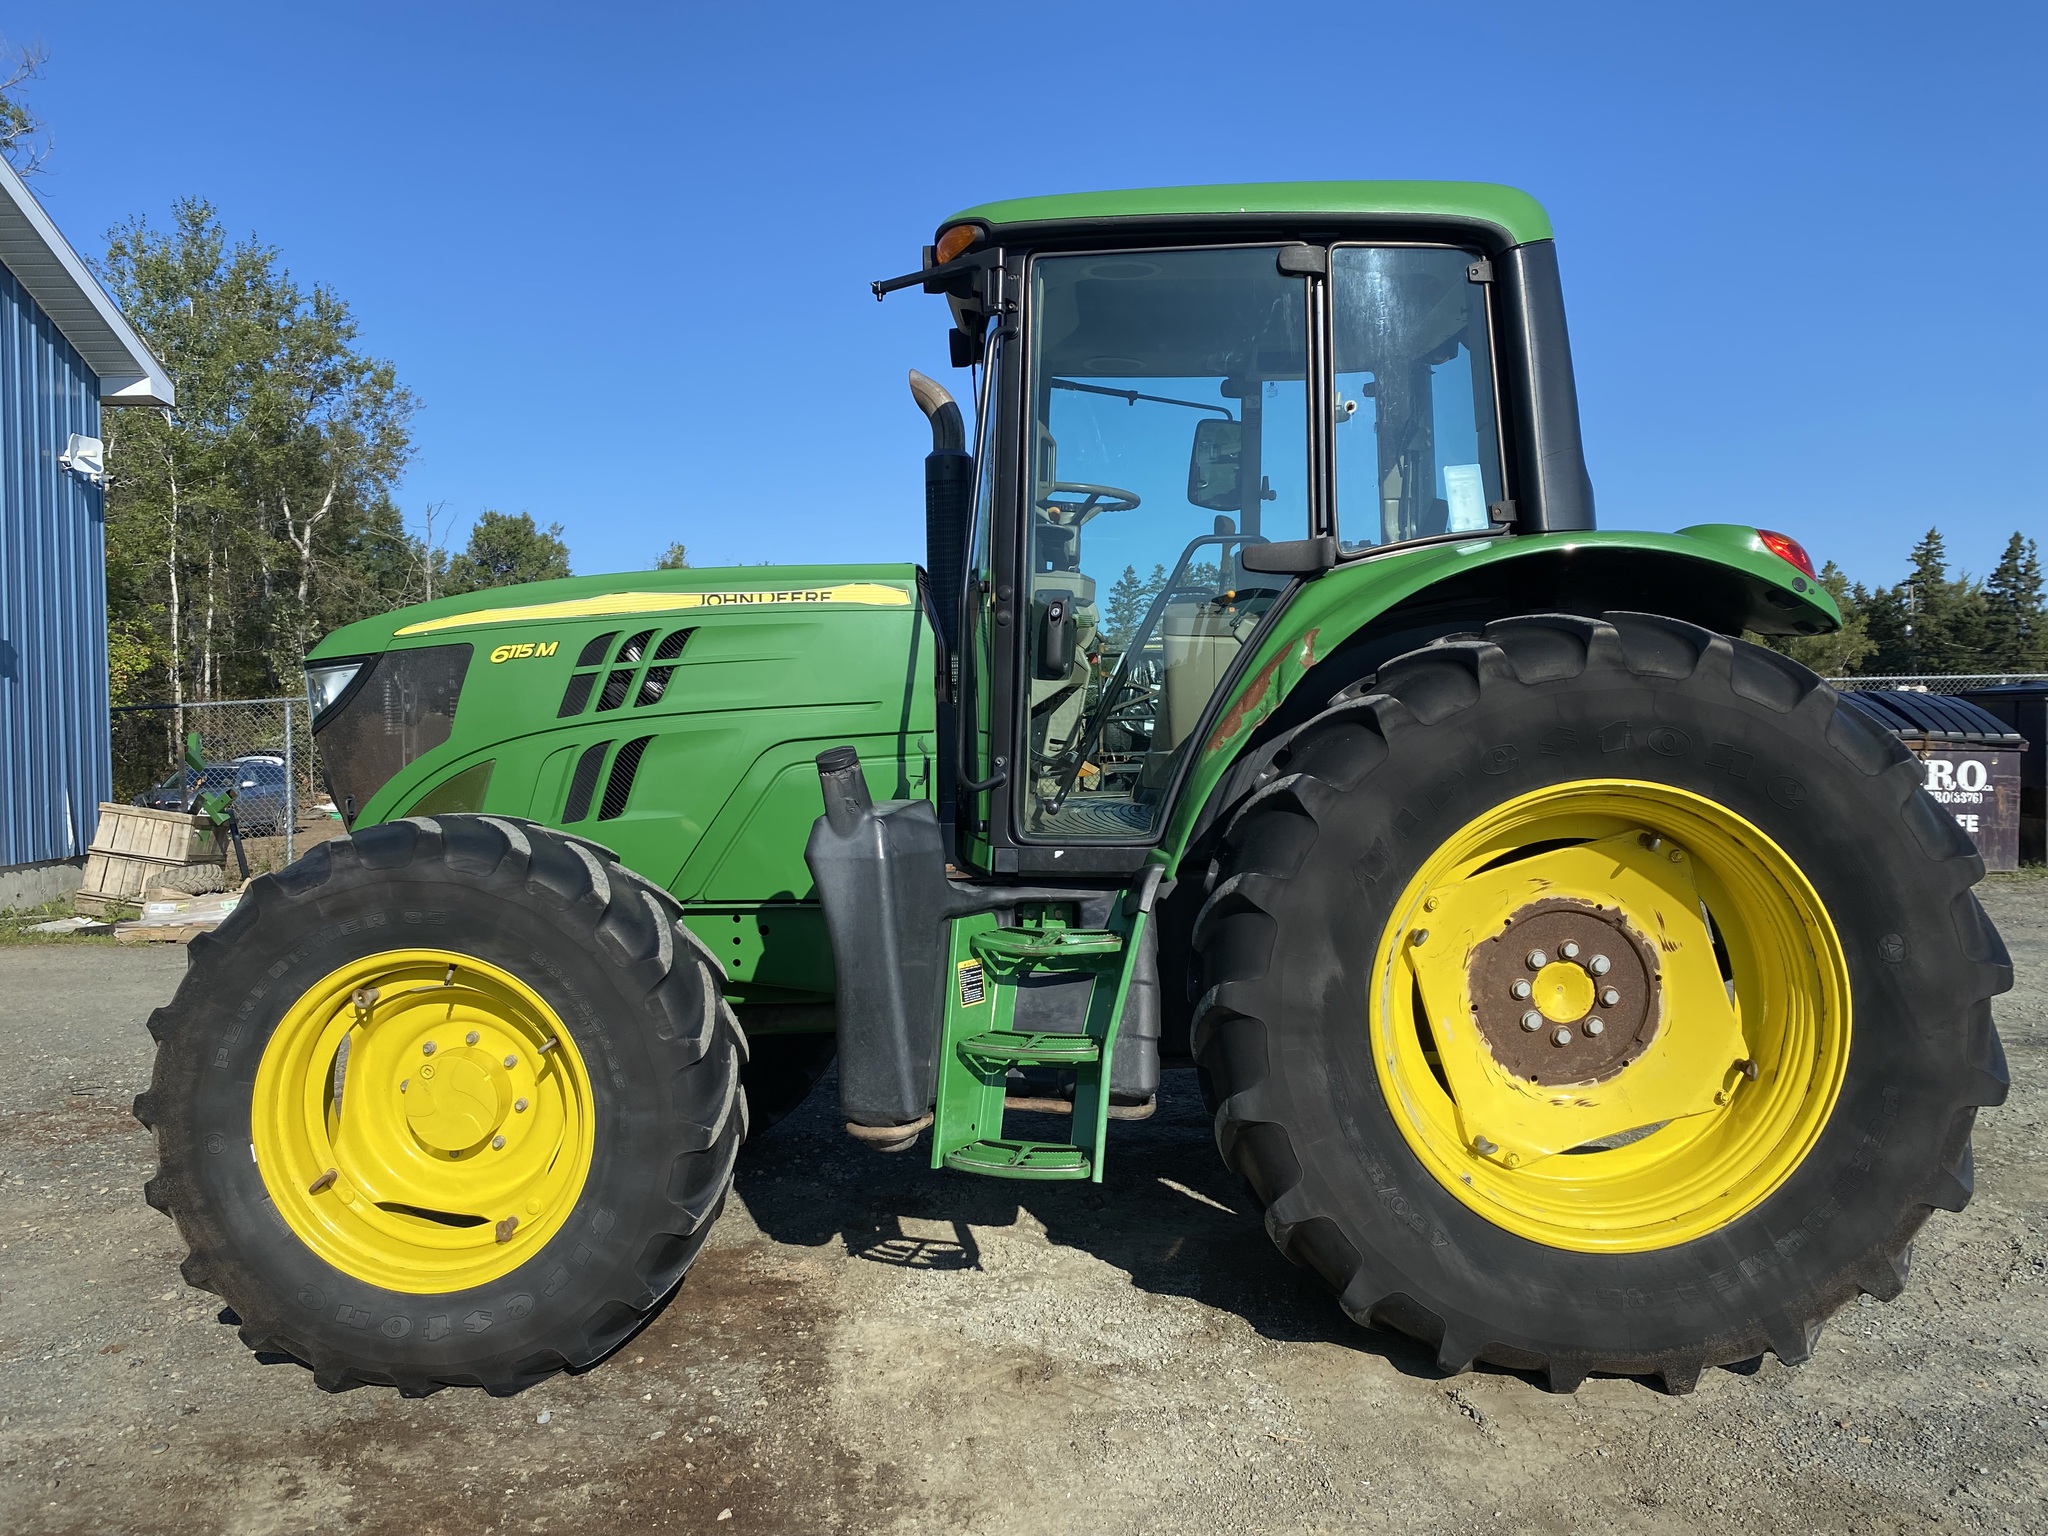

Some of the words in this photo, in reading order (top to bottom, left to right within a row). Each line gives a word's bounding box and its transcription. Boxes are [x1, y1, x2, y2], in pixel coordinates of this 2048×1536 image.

[701, 594, 753, 606] JOHN
[758, 591, 832, 603] DEERE
[214, 911, 387, 1070] PERFORMER
[403, 910, 447, 926] 85
